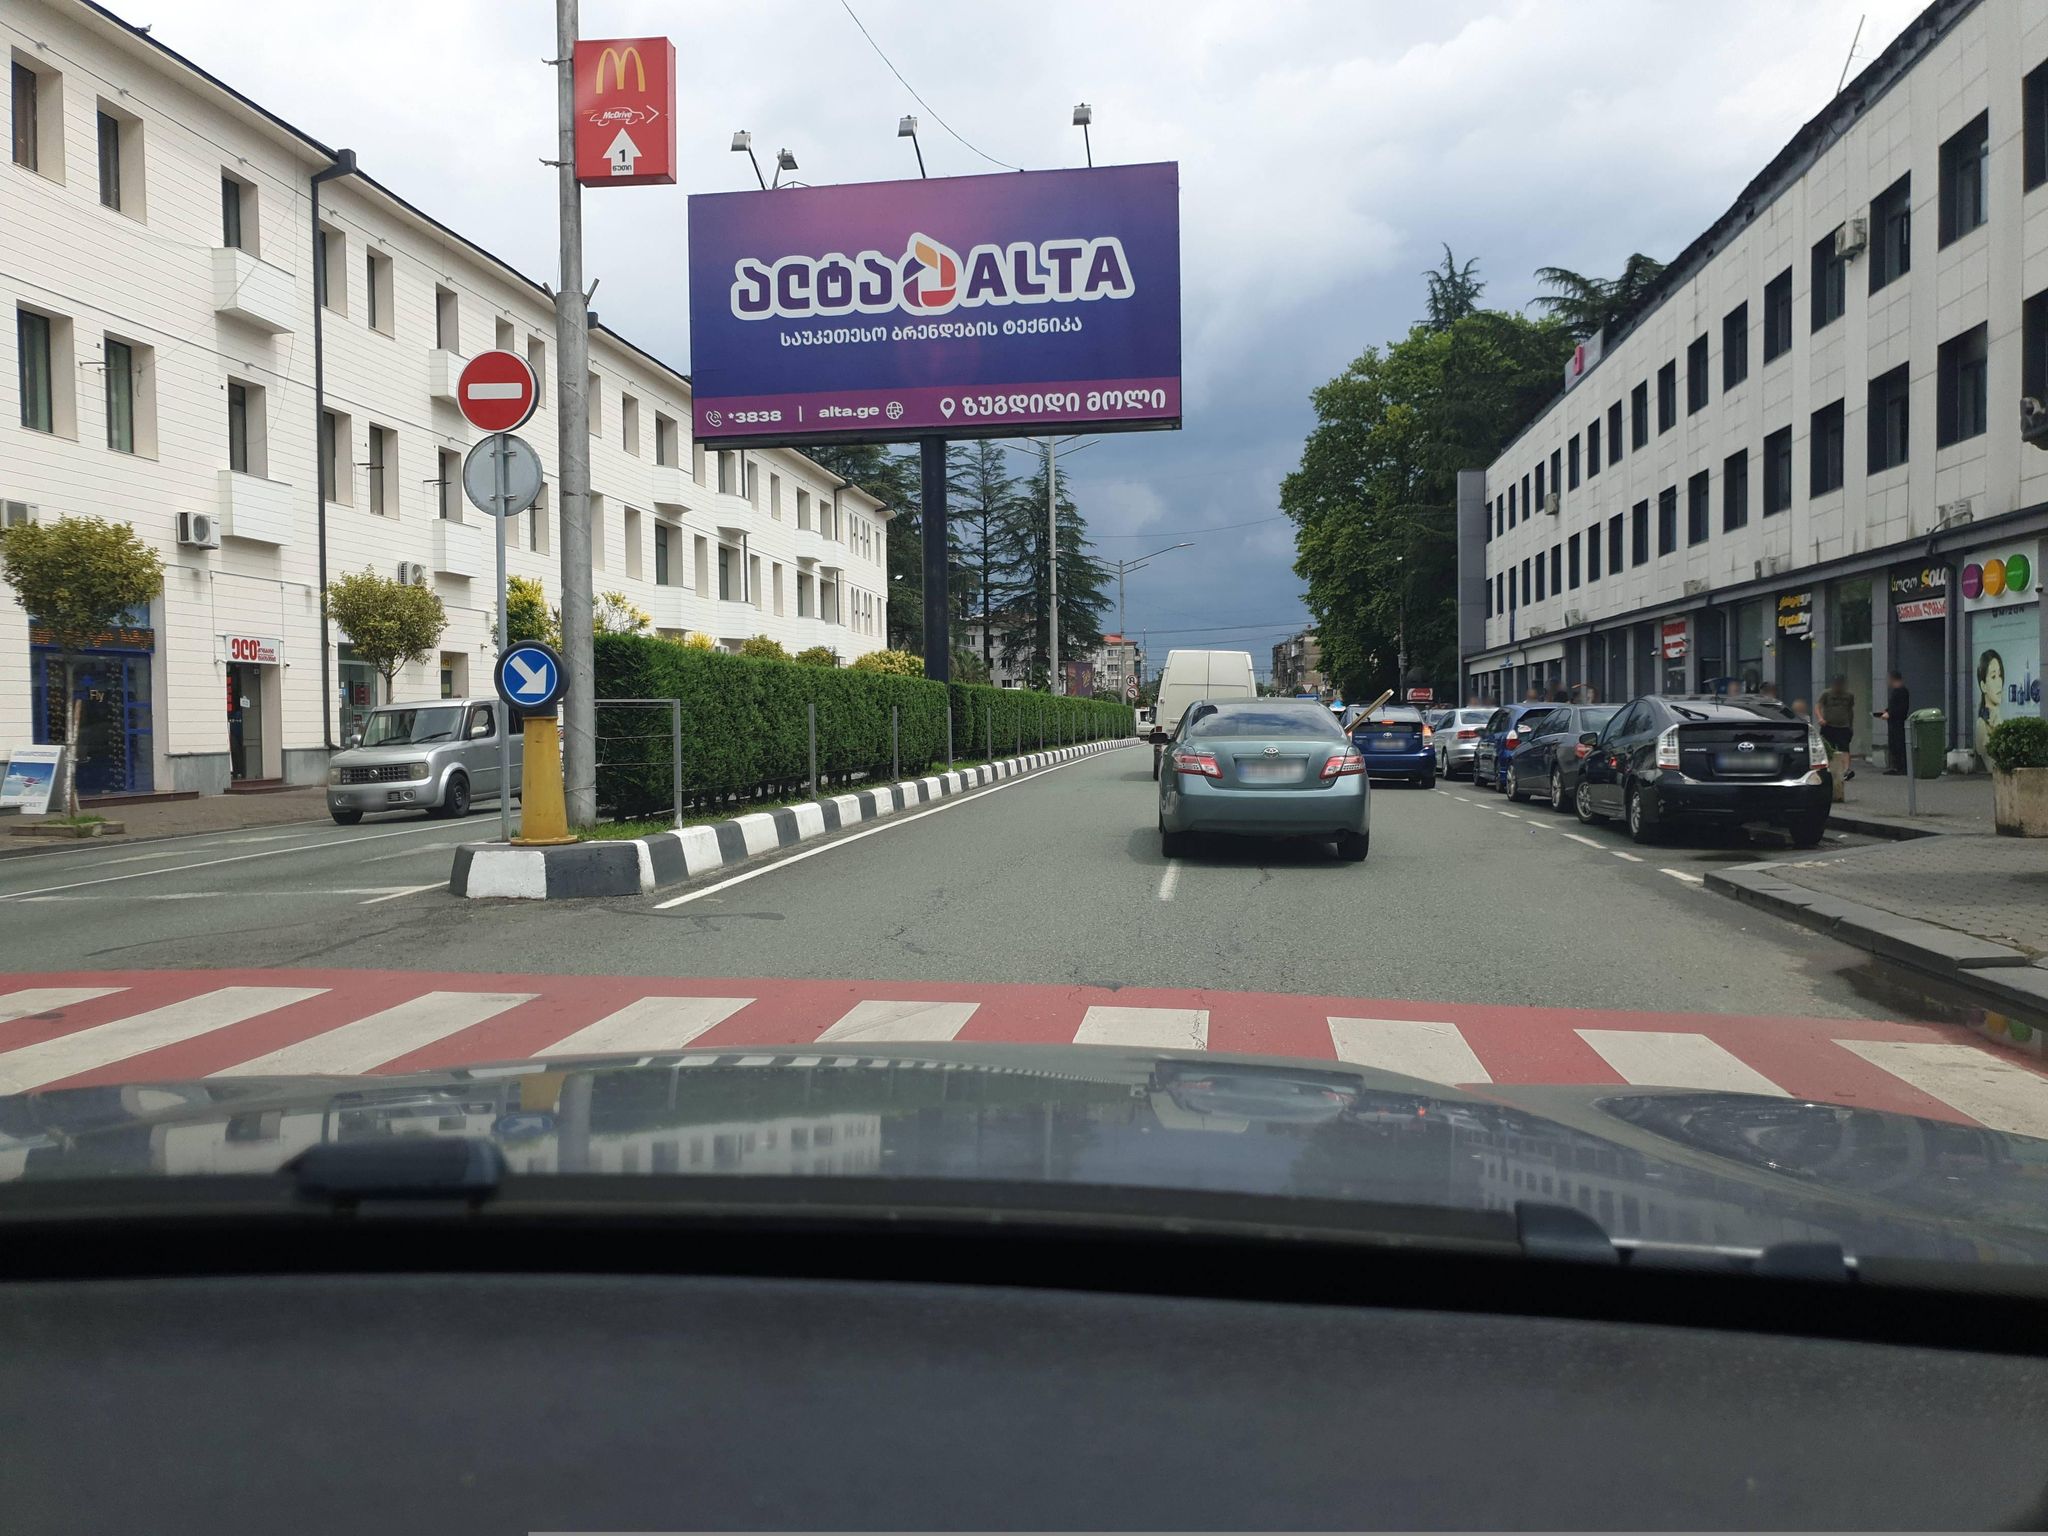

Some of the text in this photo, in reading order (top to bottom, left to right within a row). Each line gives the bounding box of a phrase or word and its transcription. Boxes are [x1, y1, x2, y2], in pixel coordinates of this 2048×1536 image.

[602, 111, 633, 120] McDrive
[618, 148, 626, 162] 1
[736, 244, 1129, 313] ალტა ALTA
[779, 316, 1084, 347] საუკეთესო ბრენდების ტექნიკა
[818, 405, 880, 419] alta.ge
[960, 388, 1167, 417] ზუგდიდი მოლი
